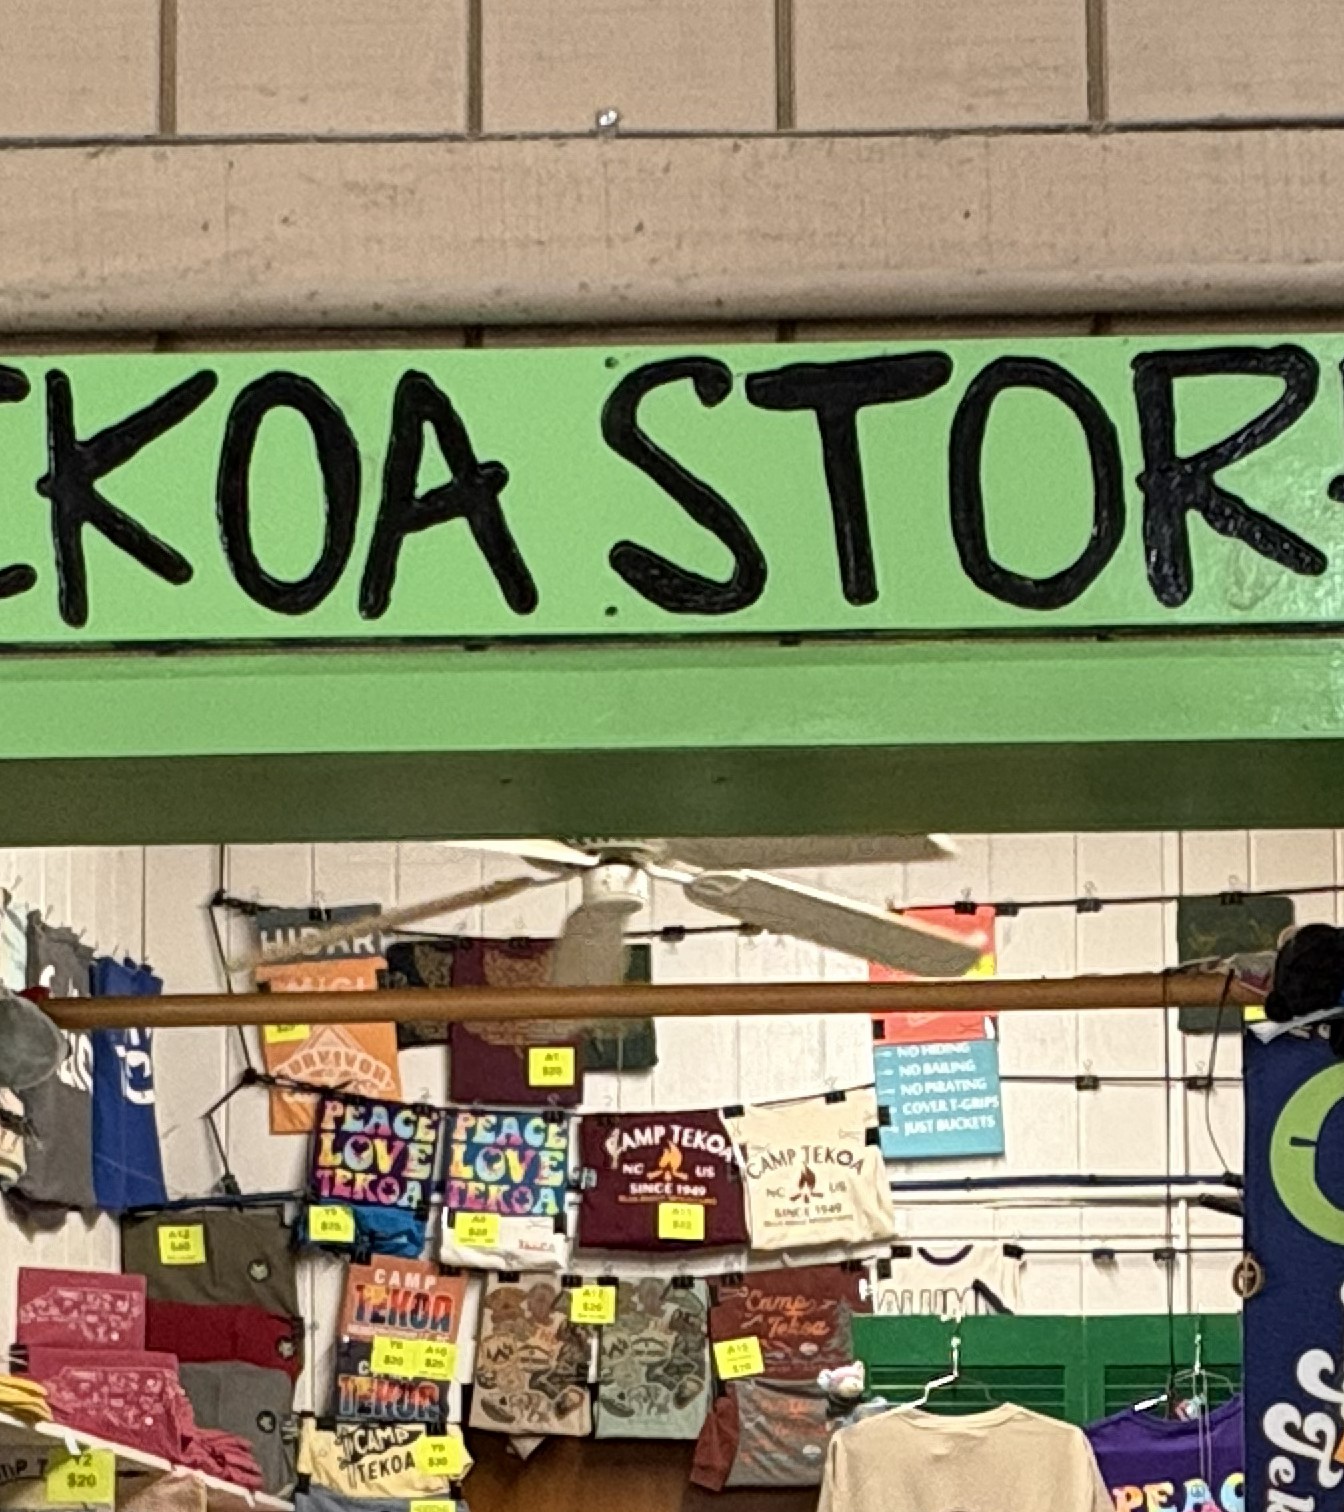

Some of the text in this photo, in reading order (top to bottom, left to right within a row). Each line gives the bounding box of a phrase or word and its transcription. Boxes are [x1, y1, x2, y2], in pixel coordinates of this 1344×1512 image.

[898, 1063, 921, 1077] NO
[900, 1078, 988, 1096] NO PIRATING
[320, 1100, 437, 1142] PEACE
[903, 1101, 948, 1115] COVER
[452, 1112, 568, 1150] PEACE
[904, 1115, 996, 1136] JUST BUCKETS
[317, 1132, 434, 1180] LOVE
[607, 1124, 734, 1164] CAMP TEKOA
[449, 1143, 566, 1186] LOVE
[622, 1162, 716, 1178] NC US
[747, 1144, 865, 1181] CAMP TEKOA
[316, 1168, 422, 1209] TEKOA
[447, 1180, 559, 1214] TEKOA
[629, 1182, 672, 1195] SINCE
[374, 1268, 437, 1290] CAMP
[355, 1427, 410, 1455] CAMP
[66, 1472, 97, 1488] $20
[356, 1451, 416, 1484] TEKOA
